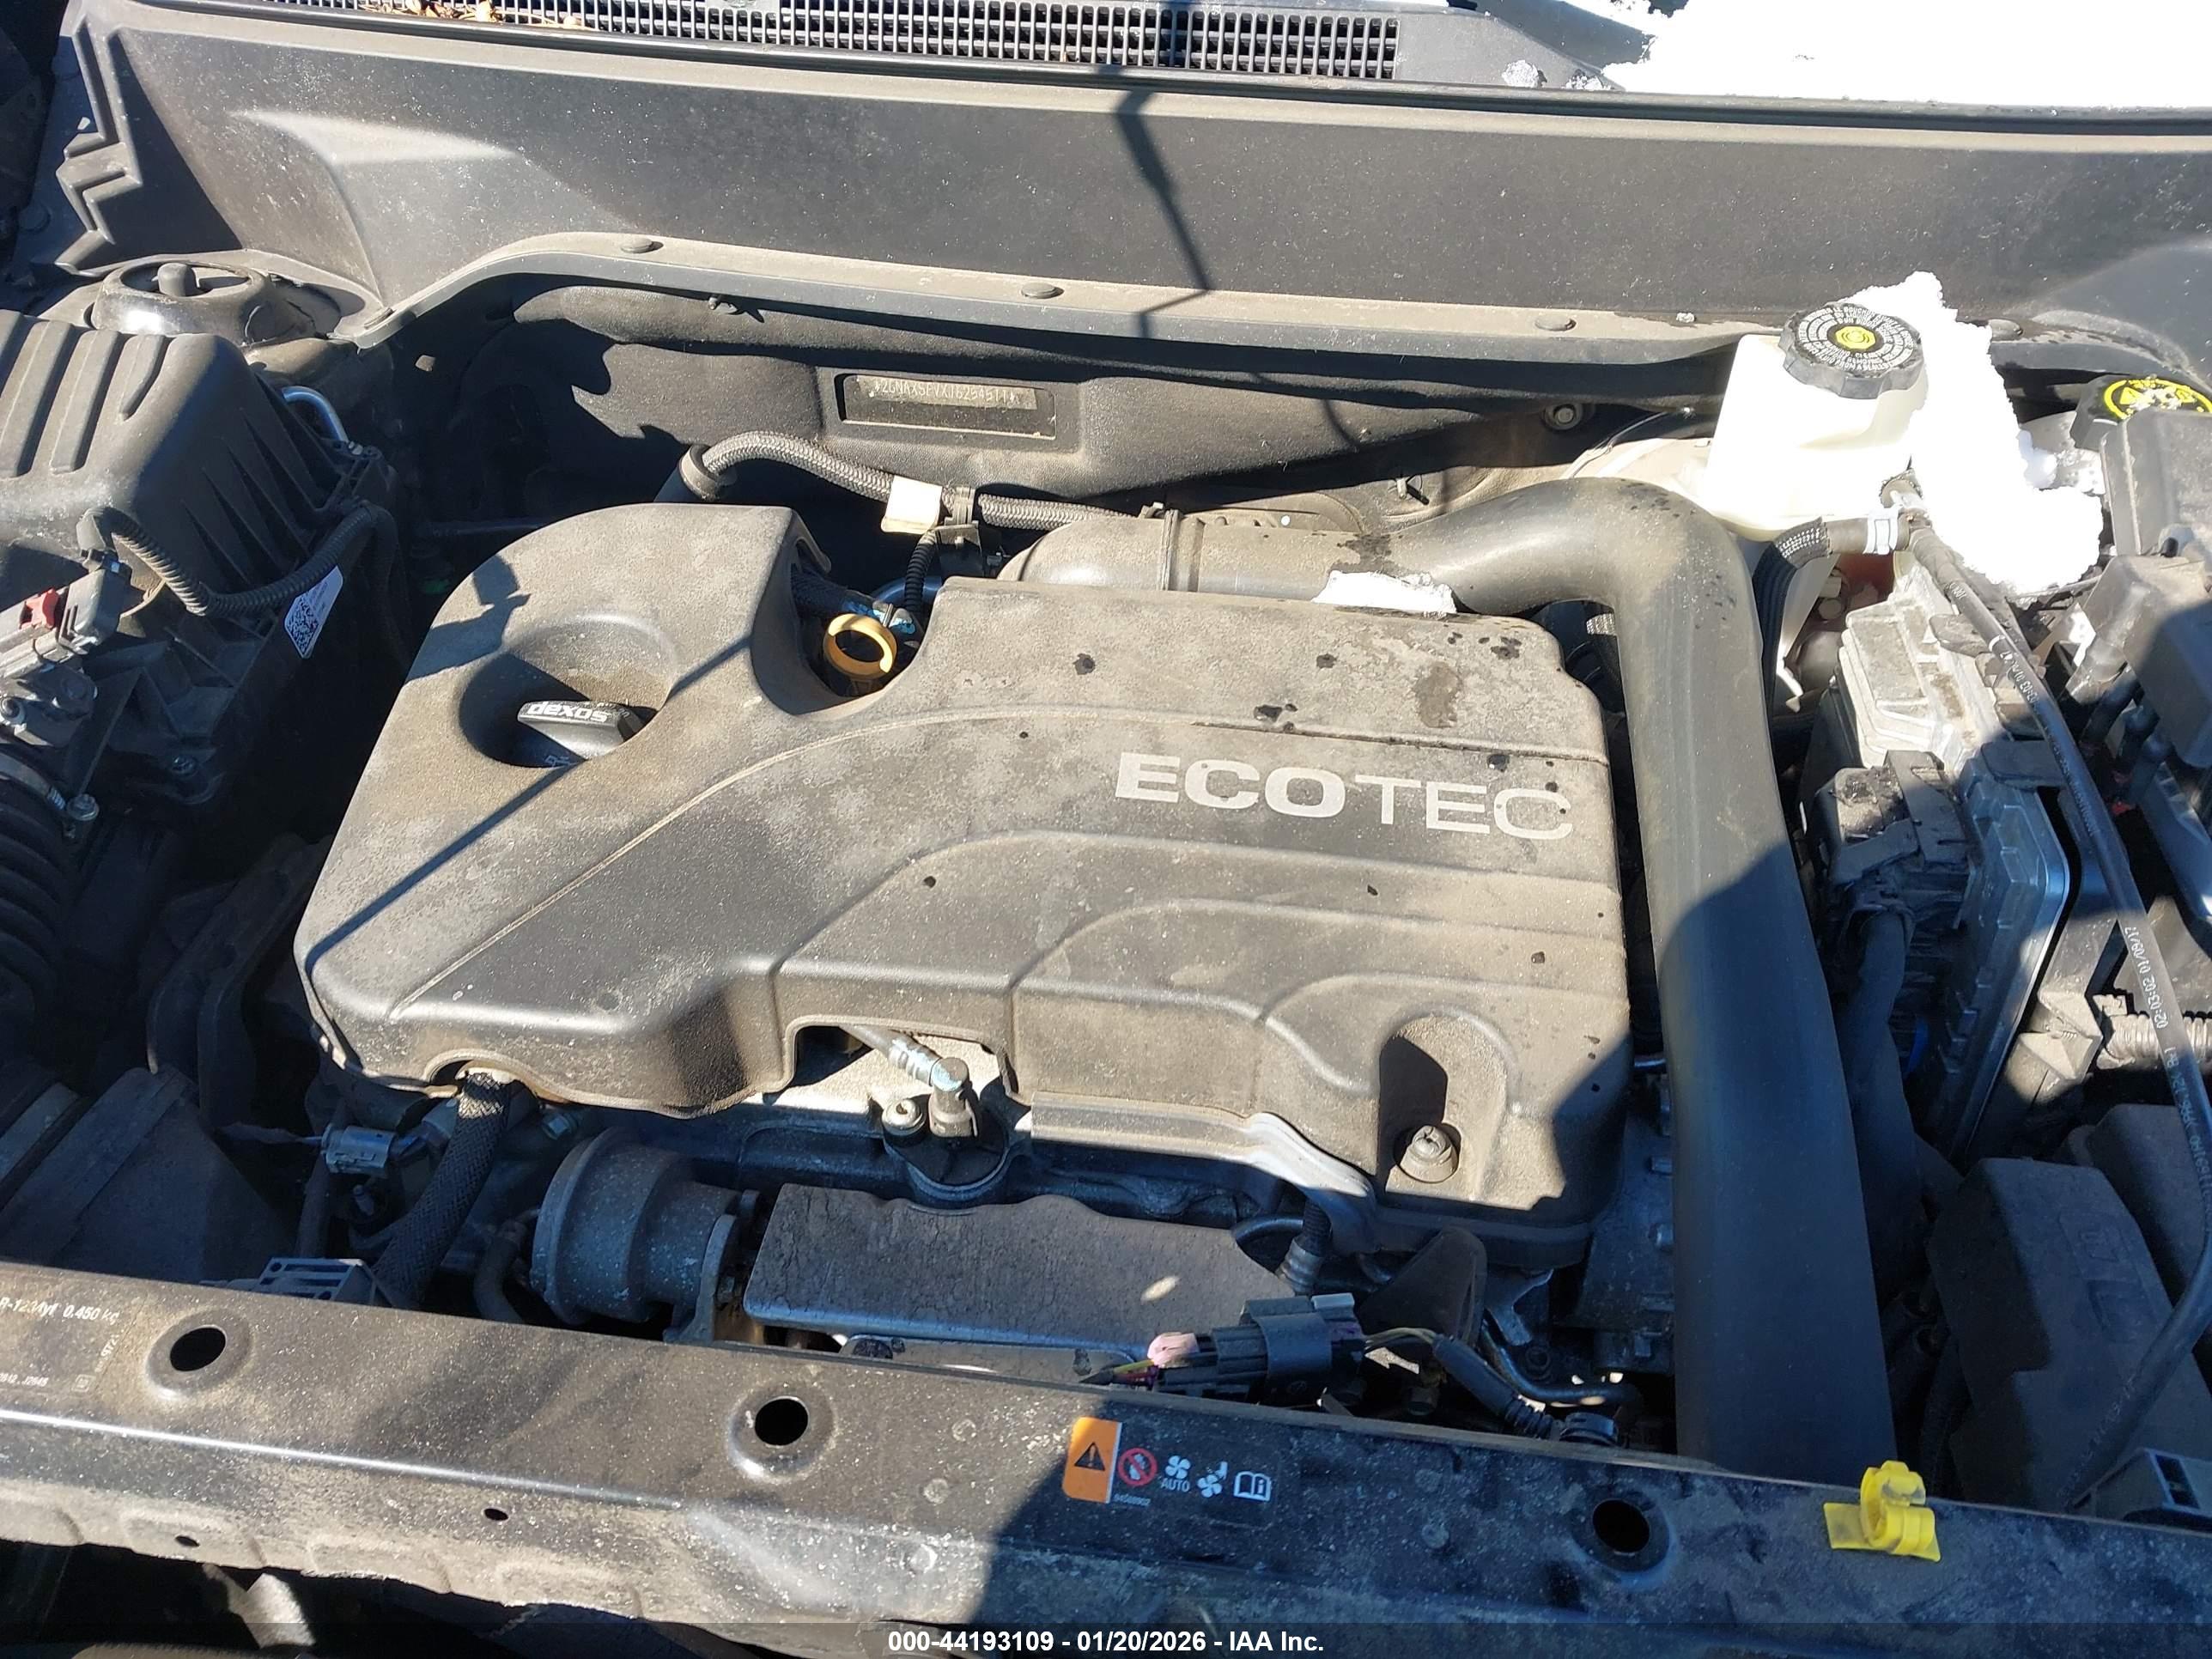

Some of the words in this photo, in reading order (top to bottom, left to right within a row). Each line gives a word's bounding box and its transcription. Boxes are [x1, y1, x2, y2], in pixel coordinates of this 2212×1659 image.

[526, 701, 611, 722] dexos
[1115, 752, 1574, 841] ECOTEC
[63, 1304, 100, 1321] 0.450
[101, 1309, 119, 1325] kg
[1161, 1477, 1191, 1492] AUTO
